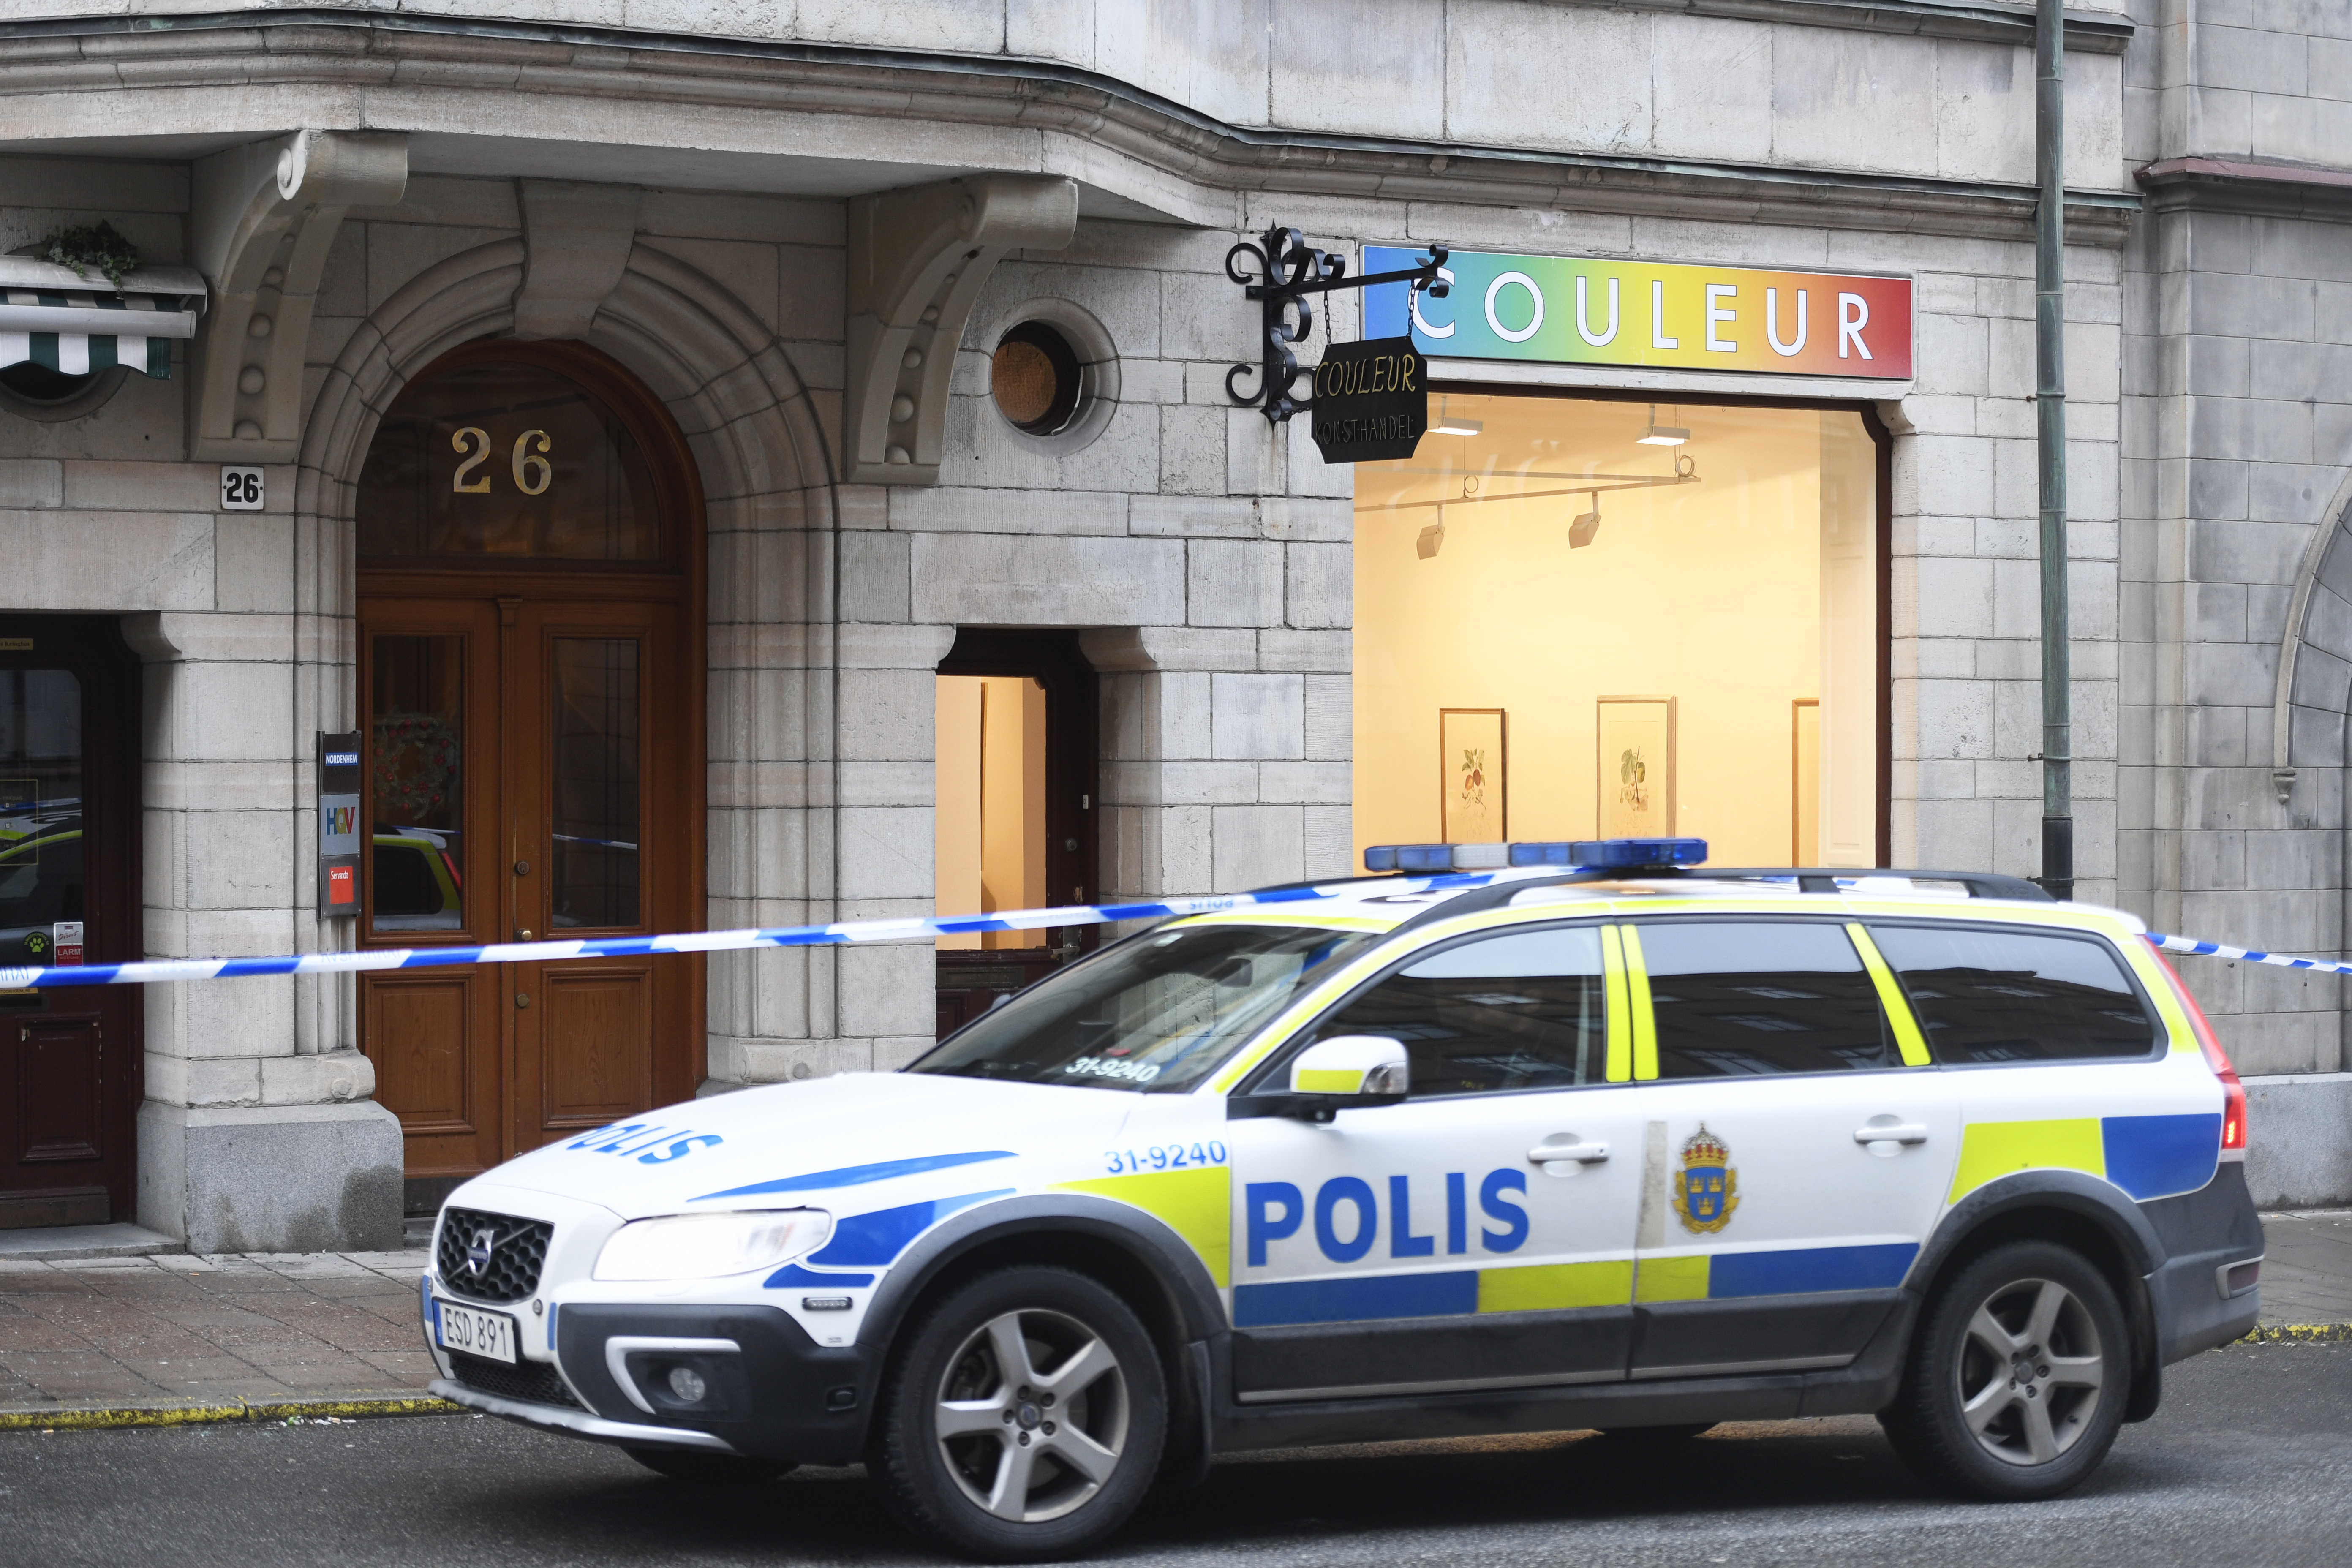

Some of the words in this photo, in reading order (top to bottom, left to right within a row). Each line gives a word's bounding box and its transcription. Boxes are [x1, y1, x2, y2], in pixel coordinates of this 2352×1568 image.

[1407, 267, 1874, 360] COULEUR
[1315, 354, 1416, 398] COULEUR
[1315, 414, 1415, 445] KONSTHANDEL
[452, 427, 552, 495] 26
[226, 472, 259, 504] 26
[326, 754, 358, 765] NORDENHEM
[326, 806, 356, 836] HQV
[331, 870, 349, 880] Servando
[1064, 1056, 1161, 1082] 31-9240
[1104, 1140, 1227, 1174] 31-9240
[1245, 1168, 1530, 1268] POLIS
[444, 1307, 472, 1347] ESD
[477, 1315, 507, 1357] 891
